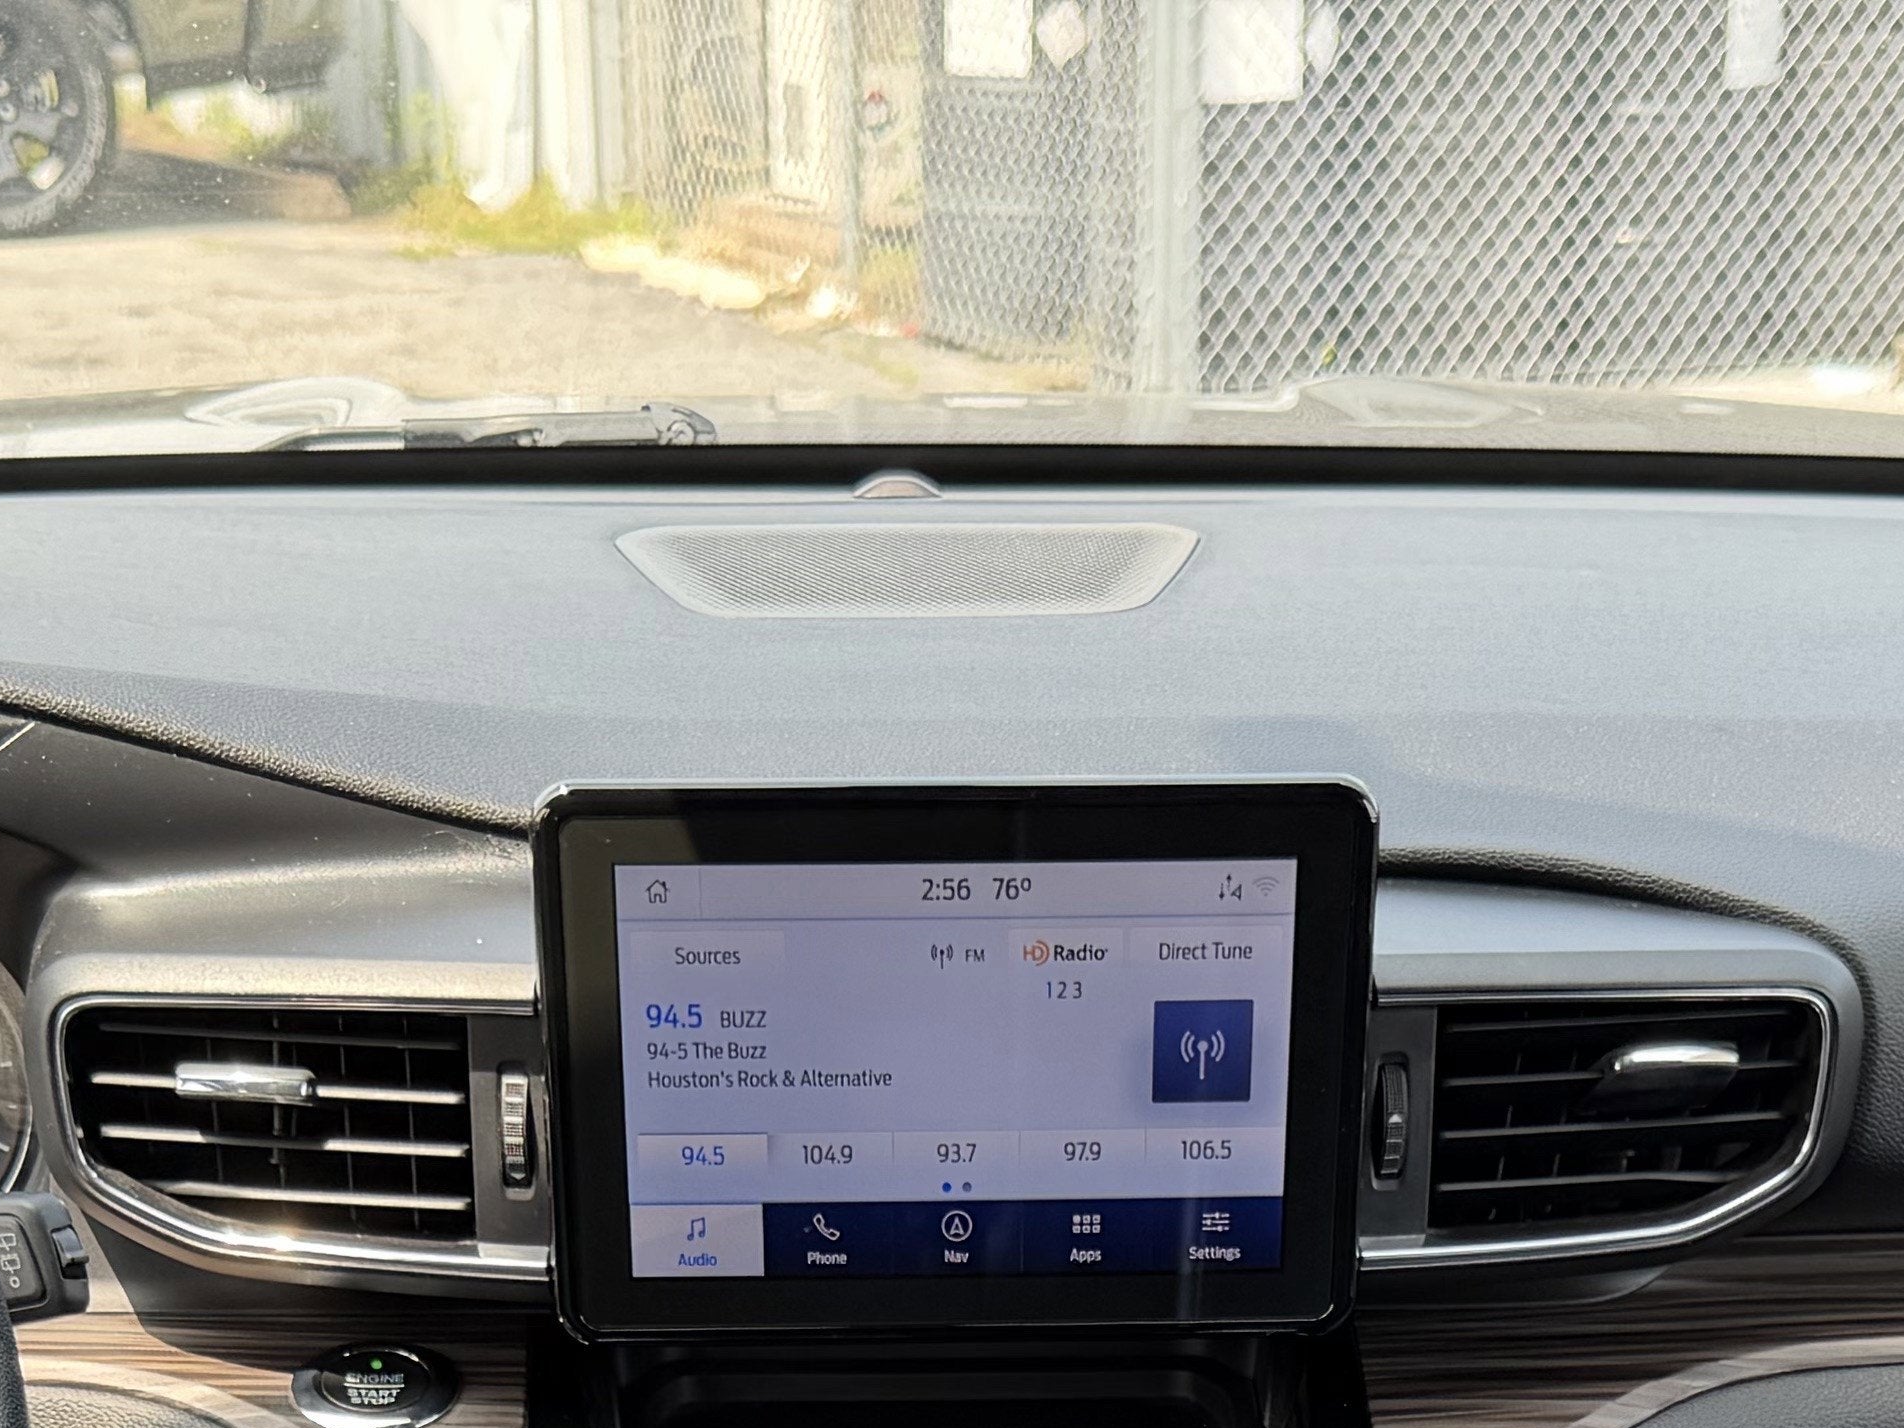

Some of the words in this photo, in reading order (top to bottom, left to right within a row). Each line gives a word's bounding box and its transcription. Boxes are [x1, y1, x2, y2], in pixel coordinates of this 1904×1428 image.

[922, 878, 971, 901] 2:56
[674, 946, 741, 966] Sources
[964, 949, 986, 963] FM
[1023, 943, 1050, 964] HD
[1053, 943, 1106, 962] Radio
[1159, 942, 1207, 961] Direct
[1212, 941, 1253, 961] Tune
[1057, 981, 1068, 999] 2
[1072, 981, 1083, 999] 3
[646, 1003, 703, 1029] 94.5
[719, 1009, 767, 1029] BUZZ
[646, 1041, 688, 1060] 94-5
[693, 1041, 724, 1060] The
[728, 1041, 767, 1060] Buzz
[648, 1070, 734, 1088] Houston's
[738, 1069, 778, 1088] Rock
[782, 1069, 796, 1088] &
[800, 1068, 893, 1087] Alternative
[681, 1146, 725, 1166] 94.5
[802, 1144, 853, 1165] 104.9
[936, 1142, 977, 1163] 93.7
[1063, 1141, 1102, 1161] 97.9
[1181, 1140, 1232, 1160] 106.5
[678, 1253, 718, 1268] Audio
[807, 1251, 847, 1265] Phone
[944, 1249, 969, 1263] Nav
[1070, 1248, 1102, 1264] Apps
[1188, 1246, 1241, 1262] Settings
[344, 1373, 404, 1384] ENGINE
[347, 1388, 400, 1397] START
